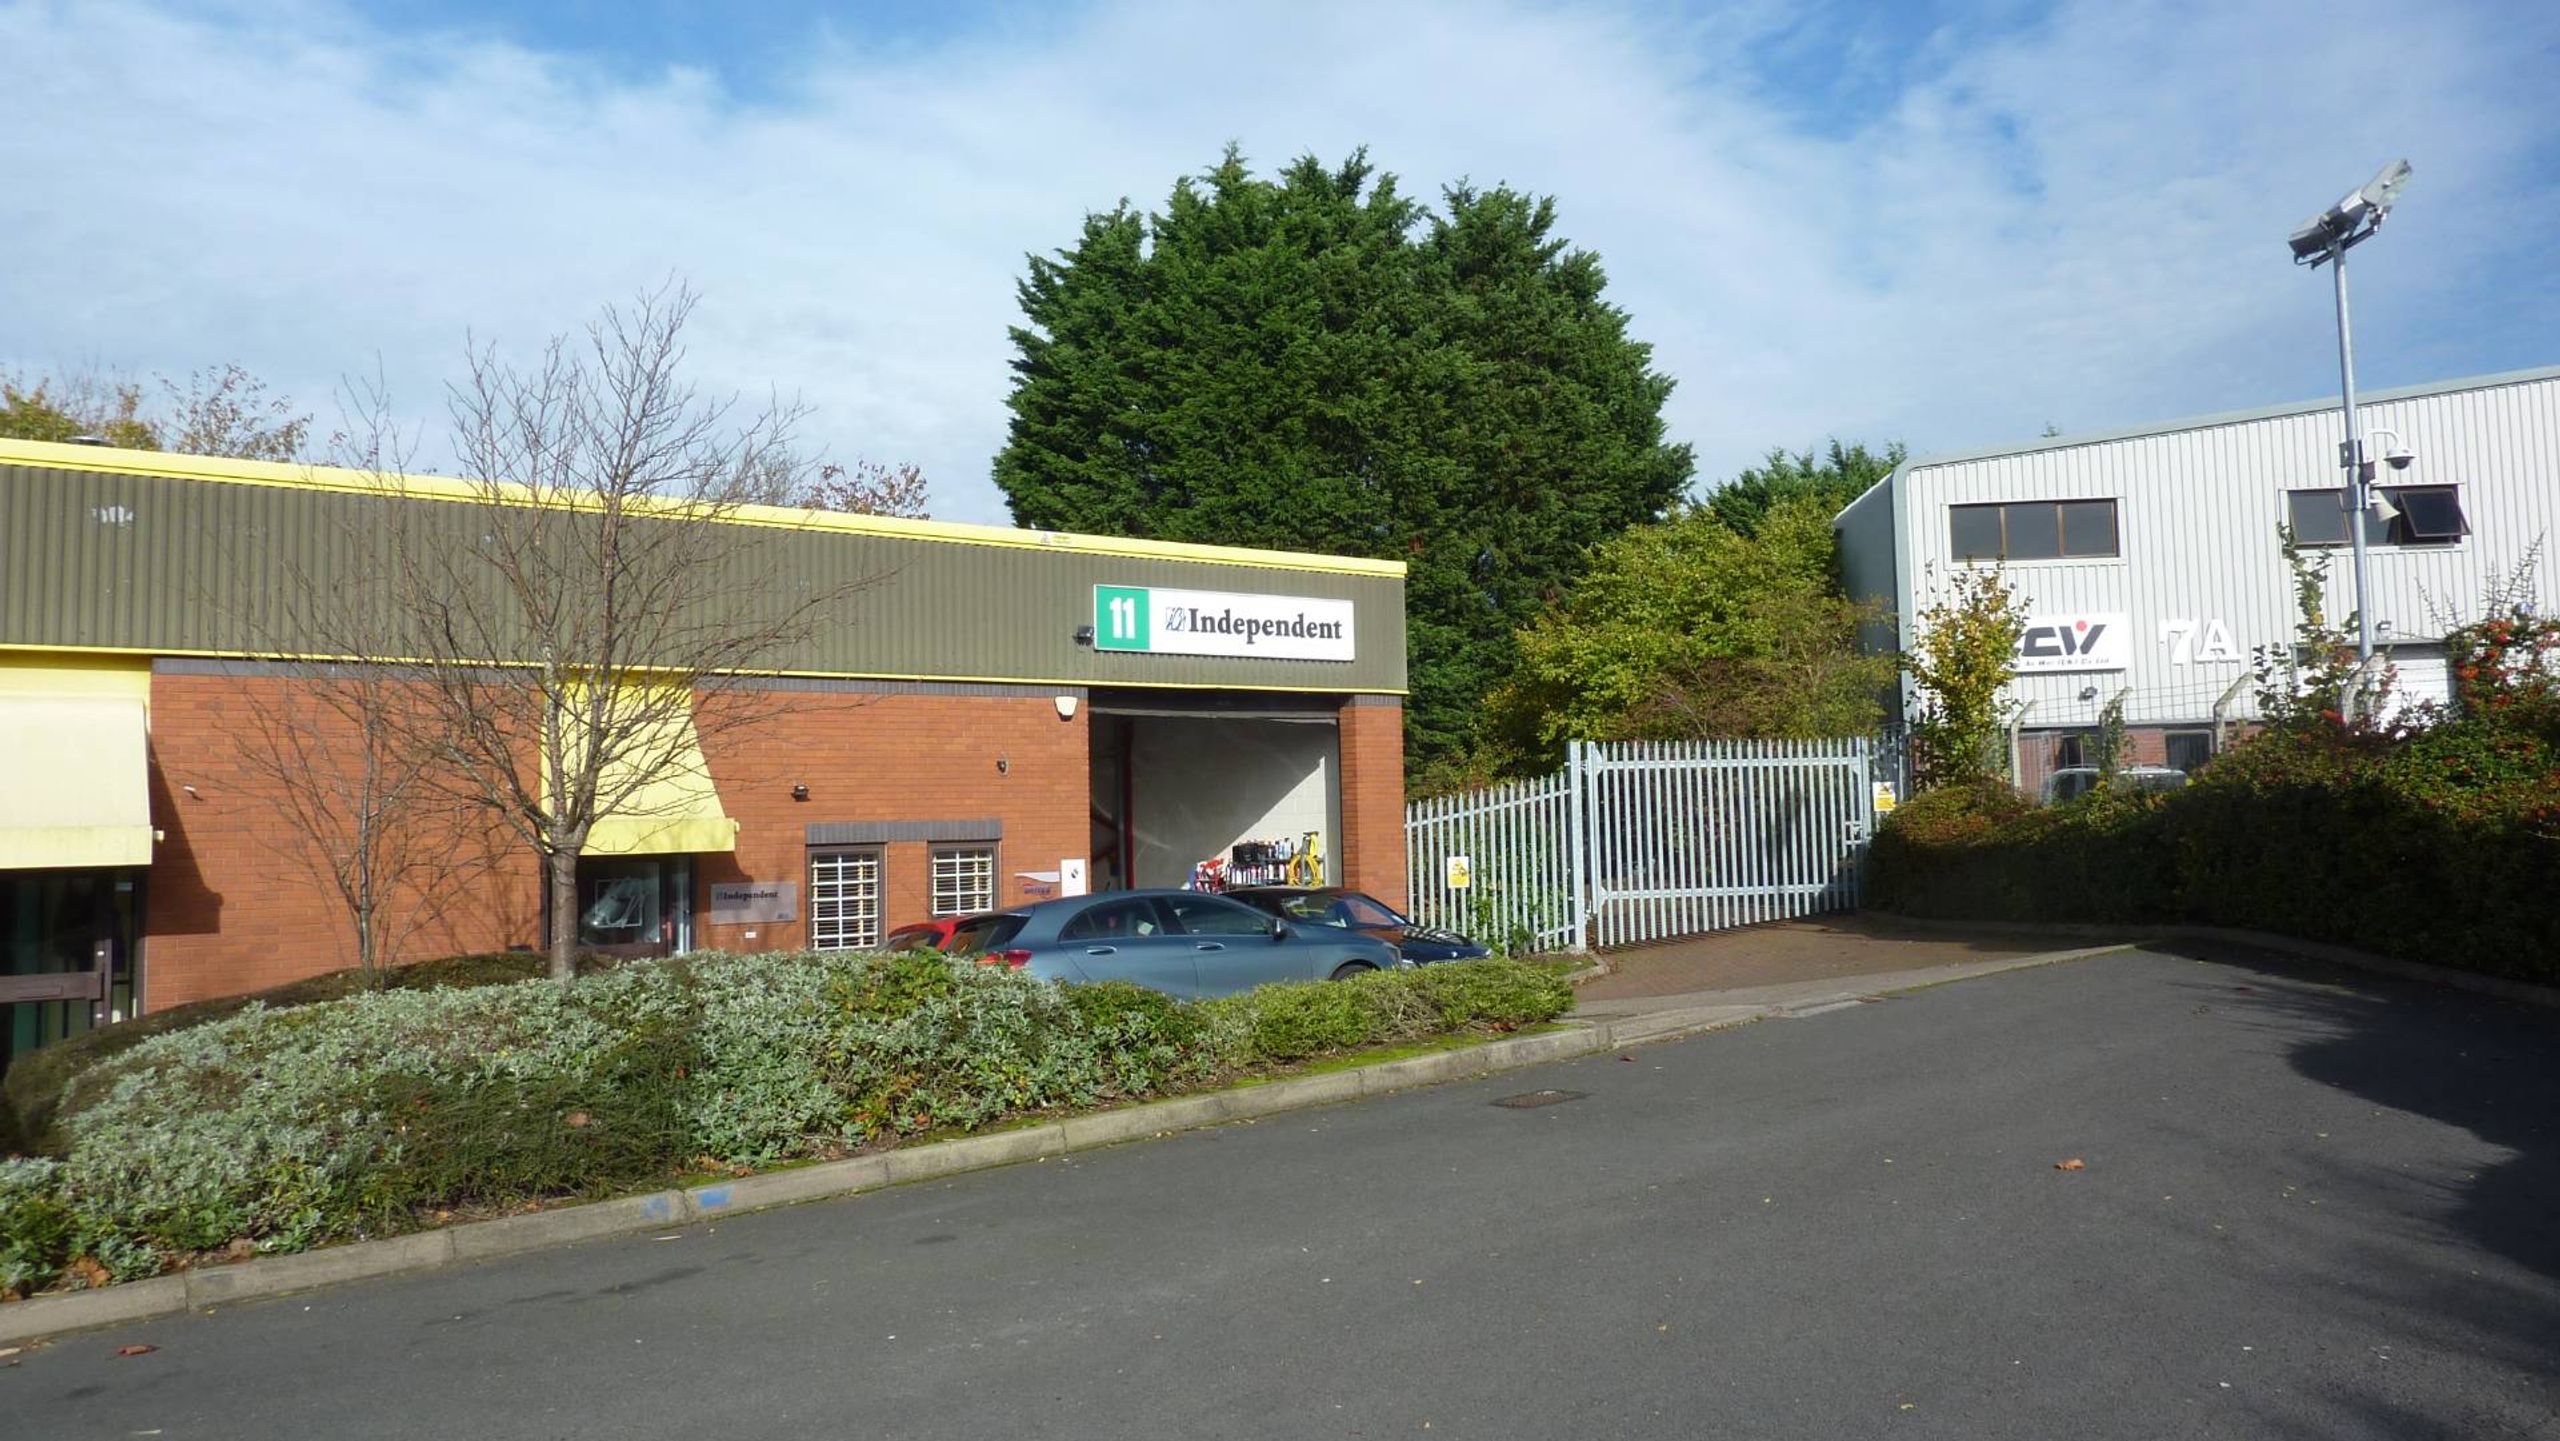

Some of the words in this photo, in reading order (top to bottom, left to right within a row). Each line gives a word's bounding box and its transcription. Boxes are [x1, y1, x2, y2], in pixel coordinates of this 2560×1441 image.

[1109, 597, 1136, 639] 11
[1188, 608, 1342, 645] Independent
[2158, 618, 2242, 666] 7A
[723, 891, 778, 901] Independent
